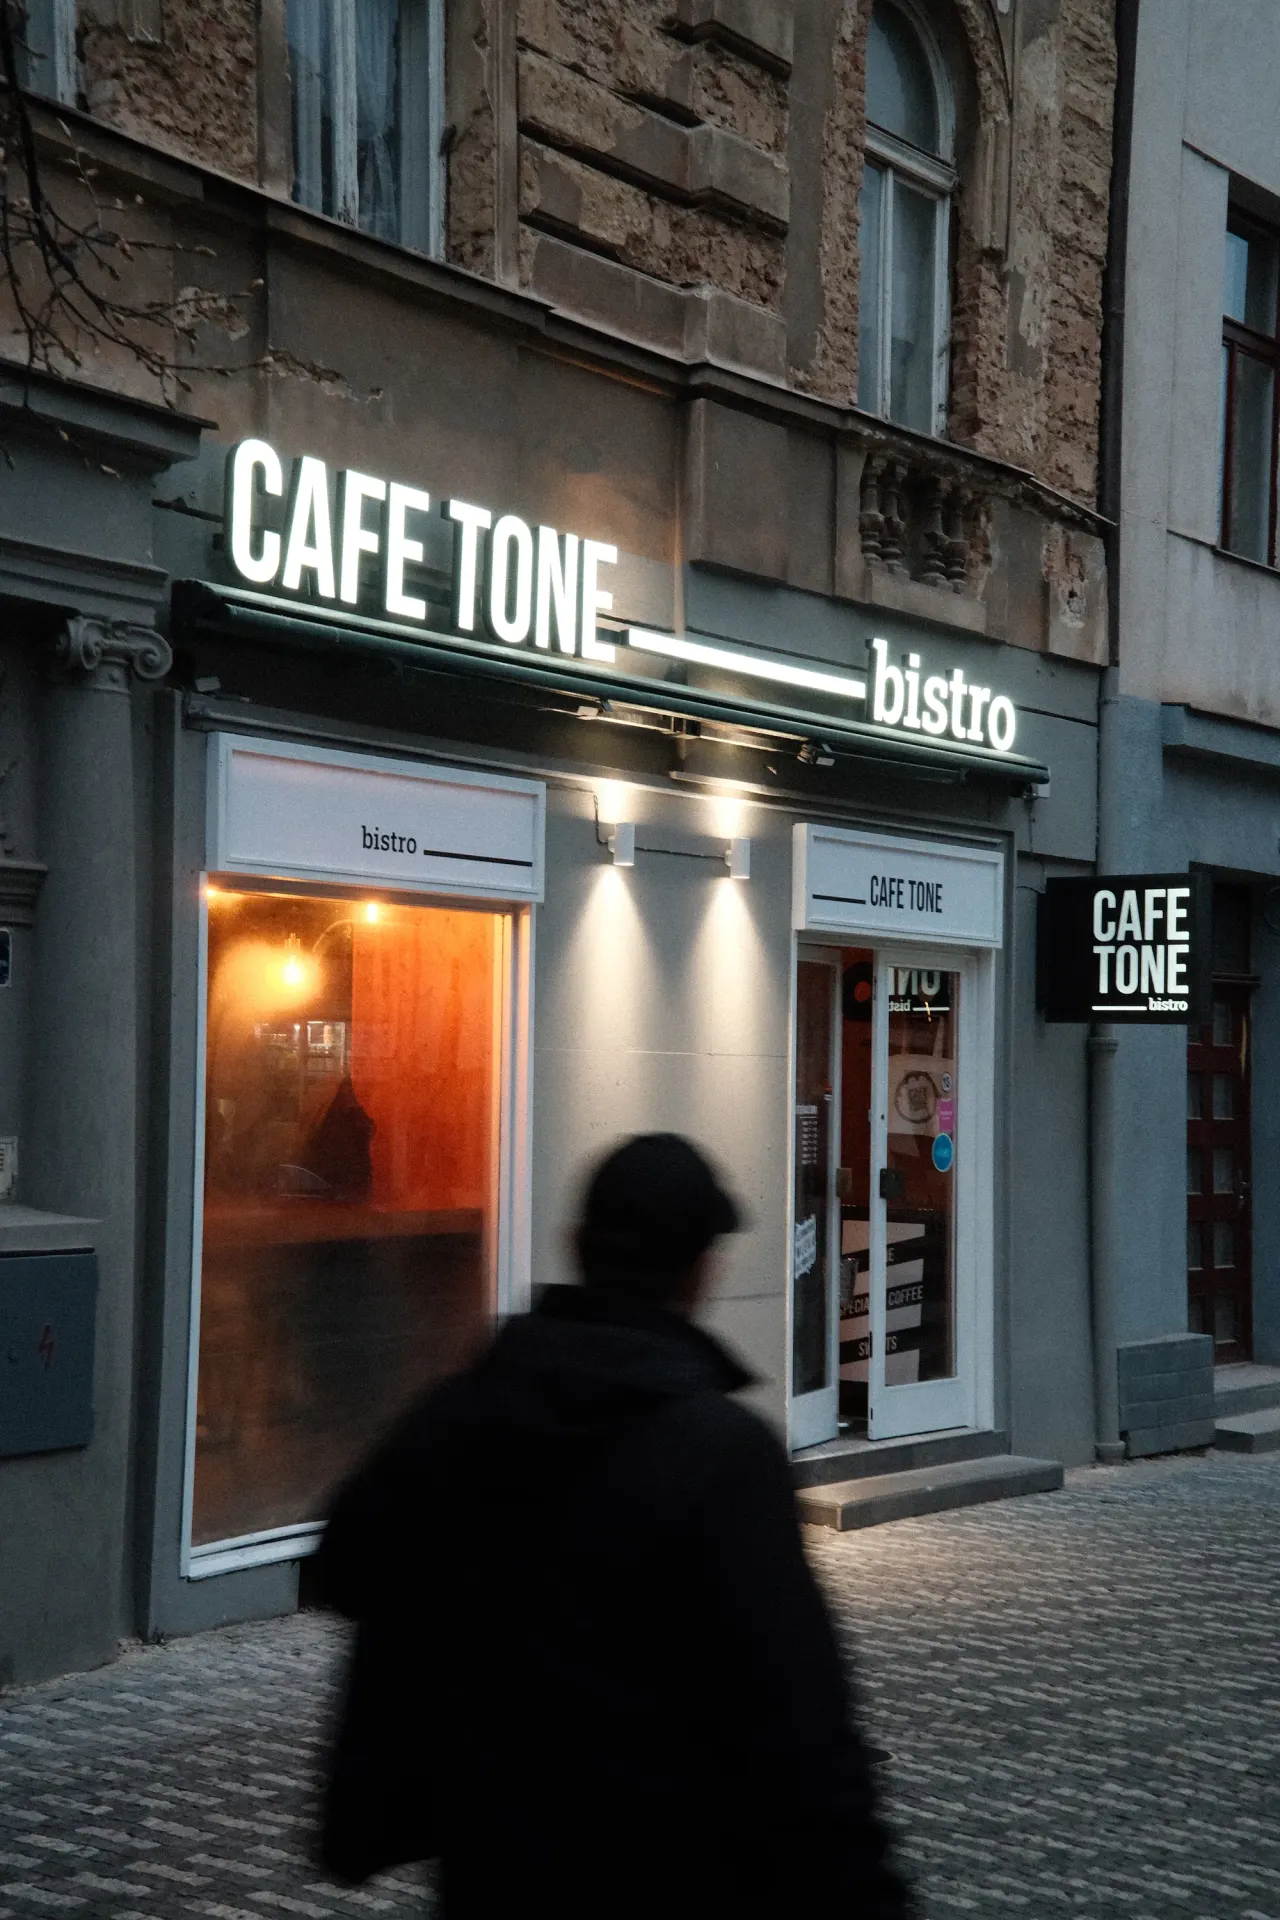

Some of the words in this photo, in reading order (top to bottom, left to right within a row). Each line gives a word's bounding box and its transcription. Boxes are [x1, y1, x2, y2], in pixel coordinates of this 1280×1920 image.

[231, 438, 430, 621] CAFE
[448, 498, 619, 664] TONE
[870, 636, 1017, 753] bistro
[361, 825, 418, 855] bistro
[870, 874, 905, 909] CAFE
[908, 879, 943, 914] TONE
[1092, 887, 1191, 942] CAFE
[1092, 943, 1191, 995] TONE
[1147, 996, 1189, 1013] bistro
[887, 1285, 924, 1306] COFFEE
